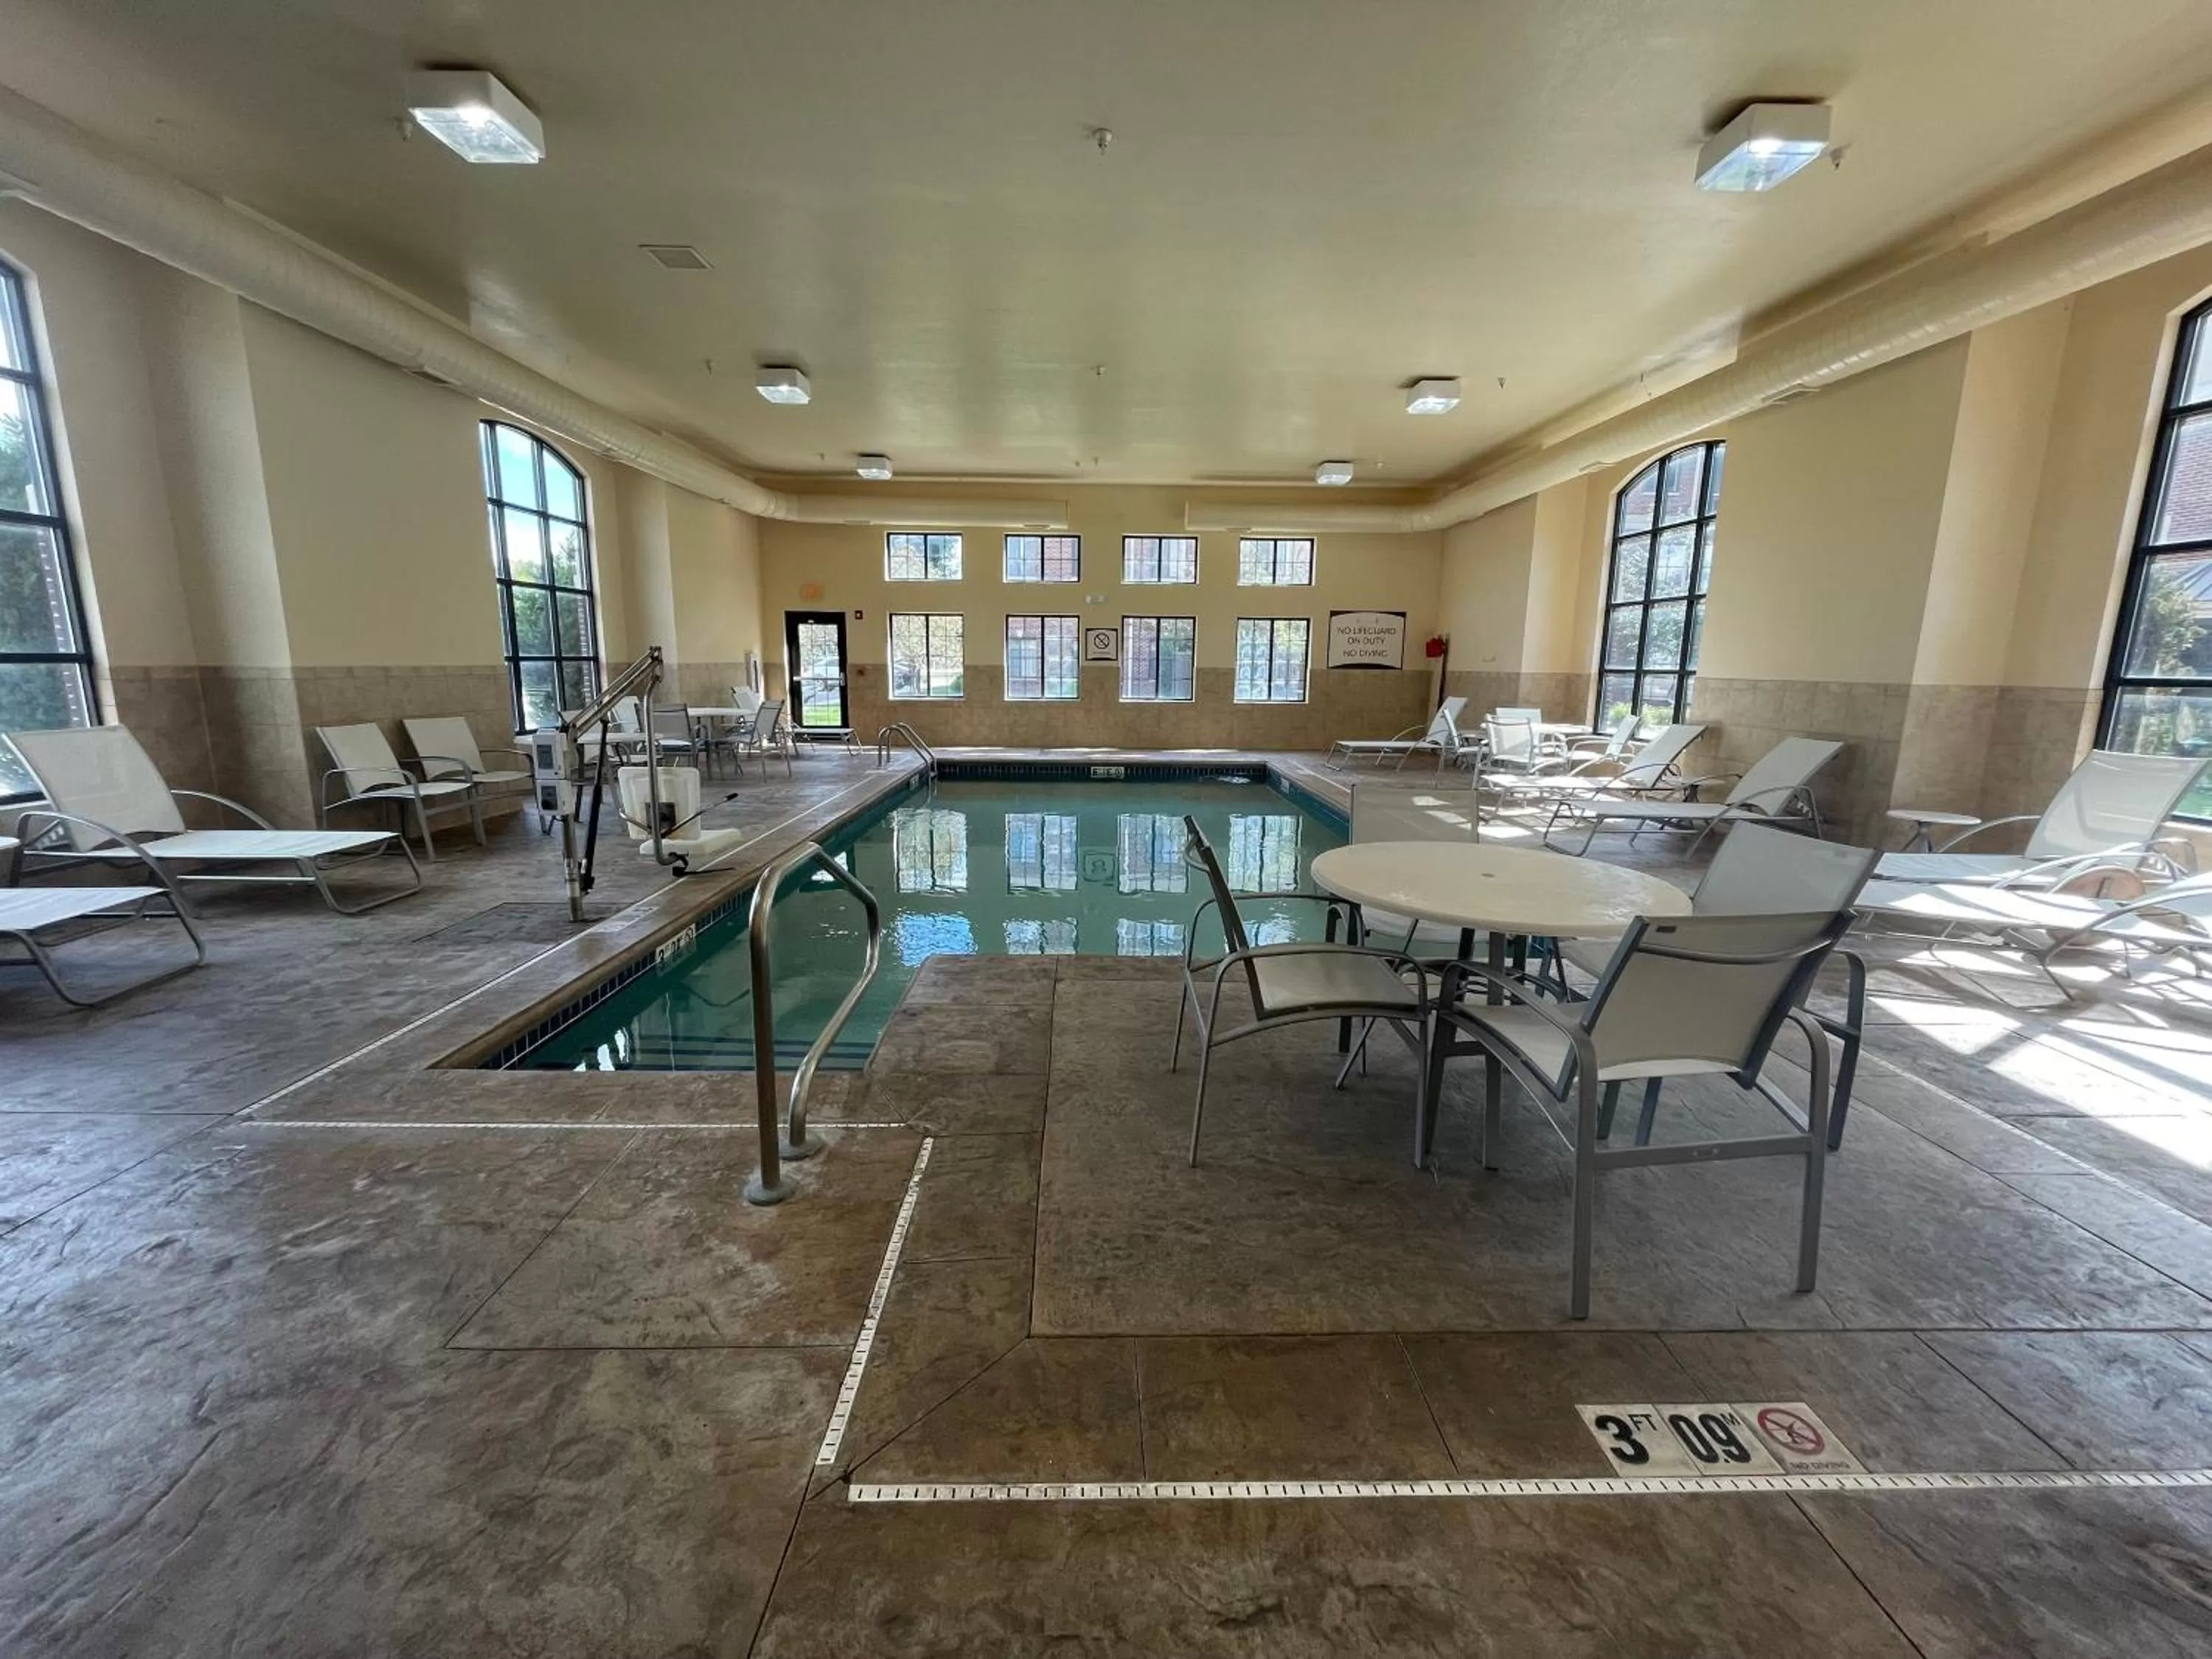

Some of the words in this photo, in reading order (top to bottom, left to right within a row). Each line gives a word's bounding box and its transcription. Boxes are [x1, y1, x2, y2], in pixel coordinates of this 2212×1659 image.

[1337, 627, 1352, 635] NO
[1347, 636, 1360, 644] ON
[1363, 636, 1386, 645] DUTY
[1343, 650, 1357, 658] NO
[1359, 649, 1389, 658] DIVING
[1595, 1414, 1649, 1464] 3
[1627, 1413, 1658, 1431] FT
